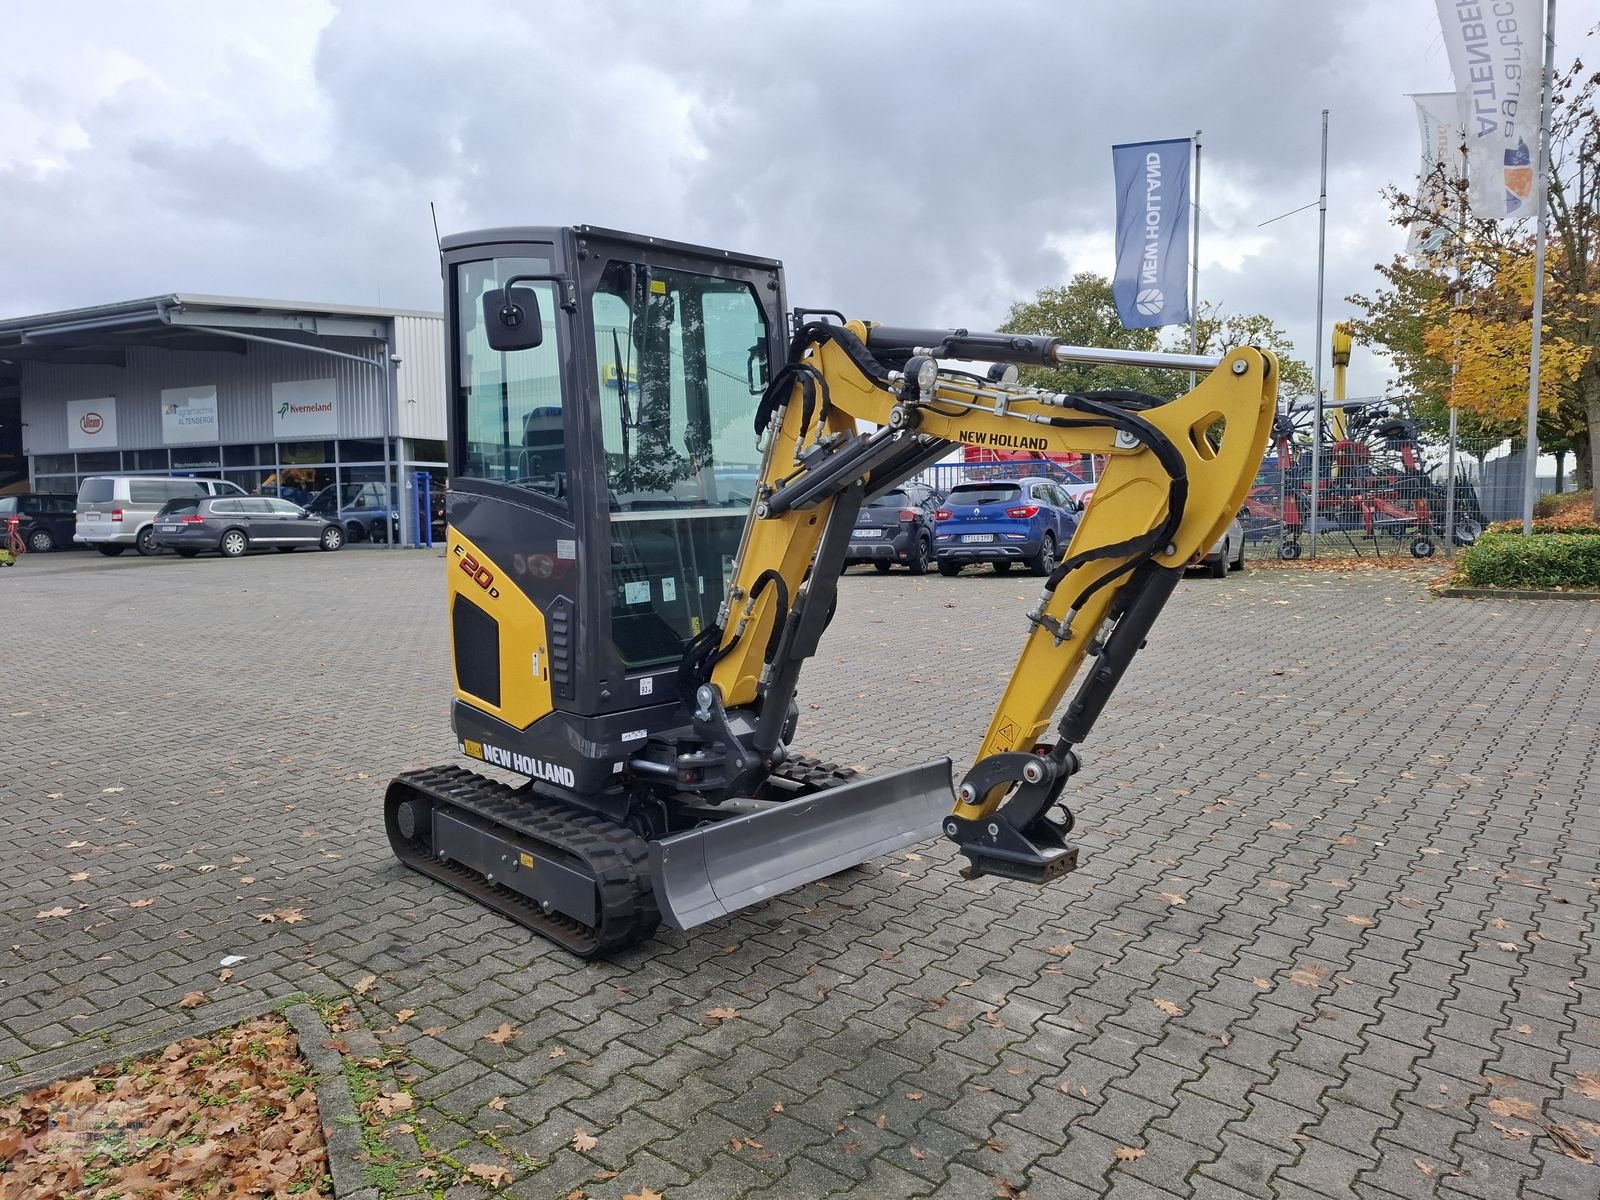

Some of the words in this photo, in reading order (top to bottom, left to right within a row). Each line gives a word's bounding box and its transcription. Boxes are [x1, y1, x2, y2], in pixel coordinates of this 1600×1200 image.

[290, 402, 332, 413] Kverneland
[178, 415, 215, 426] ALTENBERGE
[959, 430, 987, 444] NEW
[989, 433, 1048, 450] HOLLAND
[483, 743, 511, 768] NEW
[512, 753, 575, 788] HOLLAND
